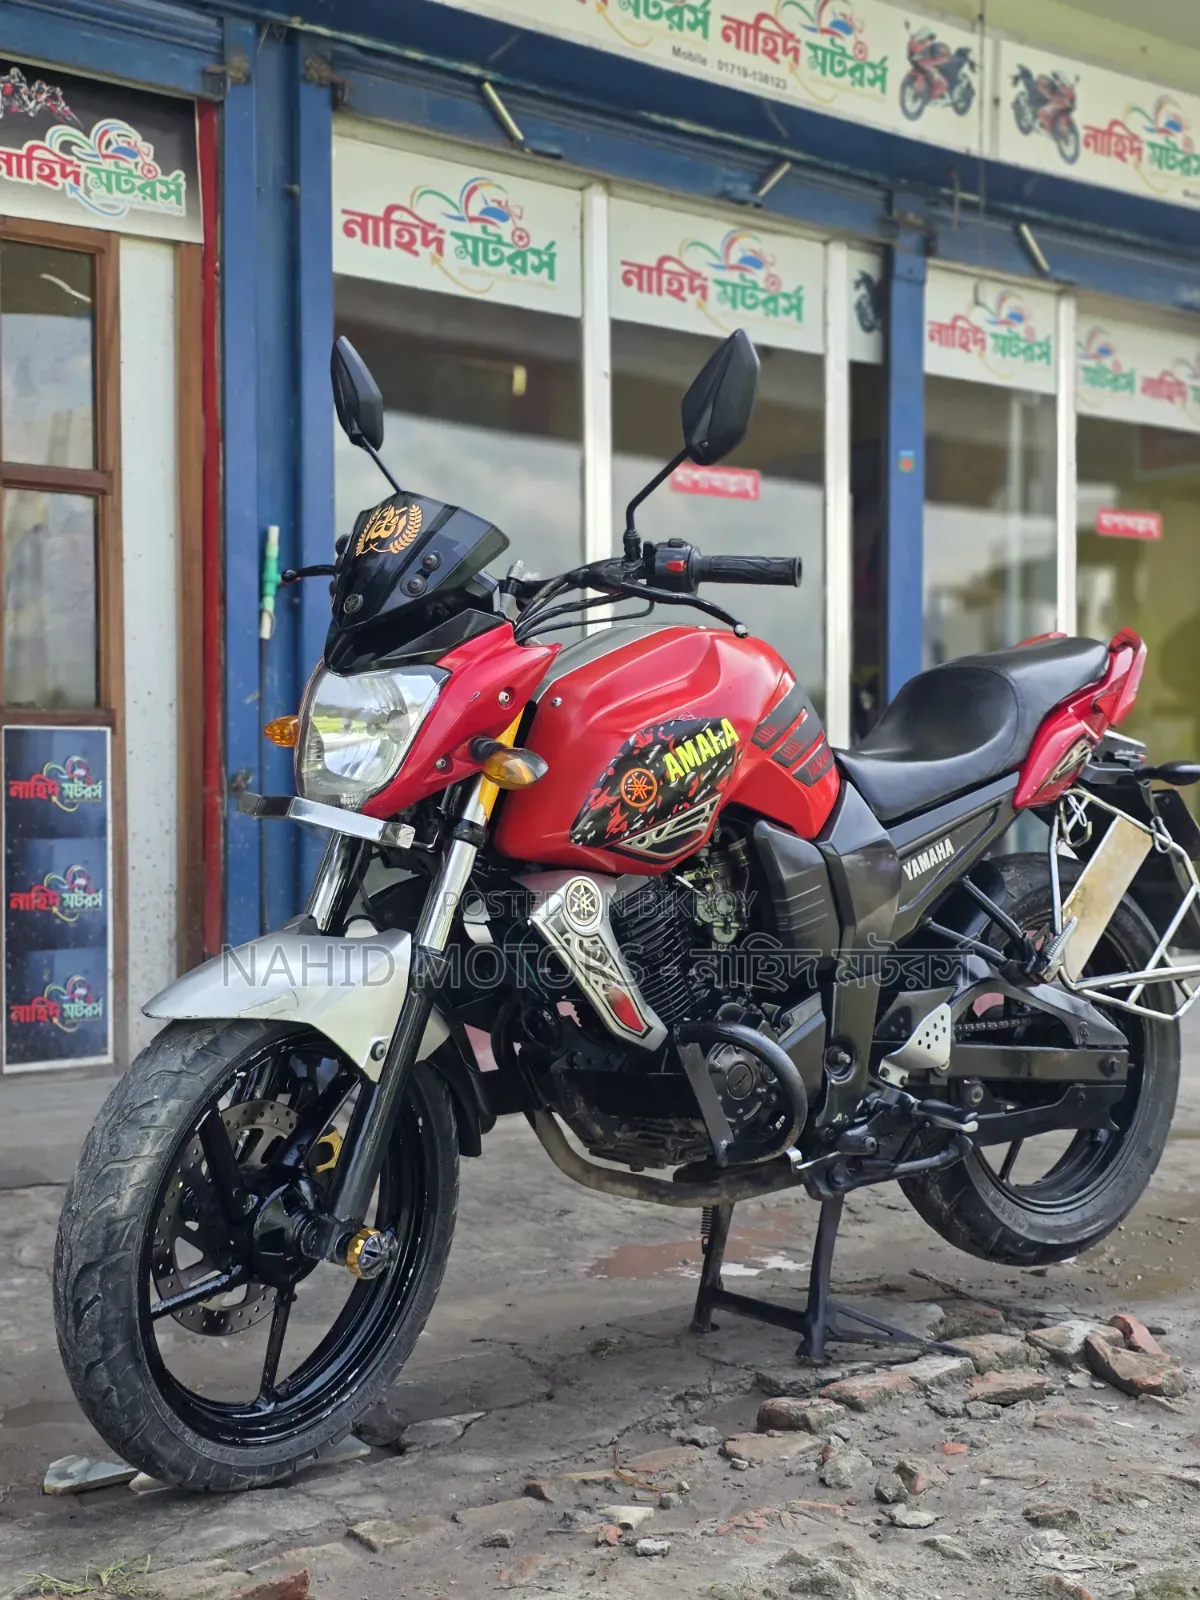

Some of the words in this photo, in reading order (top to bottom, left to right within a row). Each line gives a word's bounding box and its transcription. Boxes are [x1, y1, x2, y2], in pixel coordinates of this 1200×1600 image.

[671, 45, 708, 66] Mobile
[720, 12, 801, 66] নাহিদ
[1082, 119, 1144, 164] নাহিদ
[340, 203, 446, 258] নাহিদ
[620, 254, 710, 304] নাহিদ
[927, 313, 987, 354] নাহিদ
[8, 772, 60, 801] নাহিদ
[902, 838, 955, 881] YAMAHA
[8, 883, 60, 911] নাহিদ
[9, 994, 61, 1024] নাহিদ
